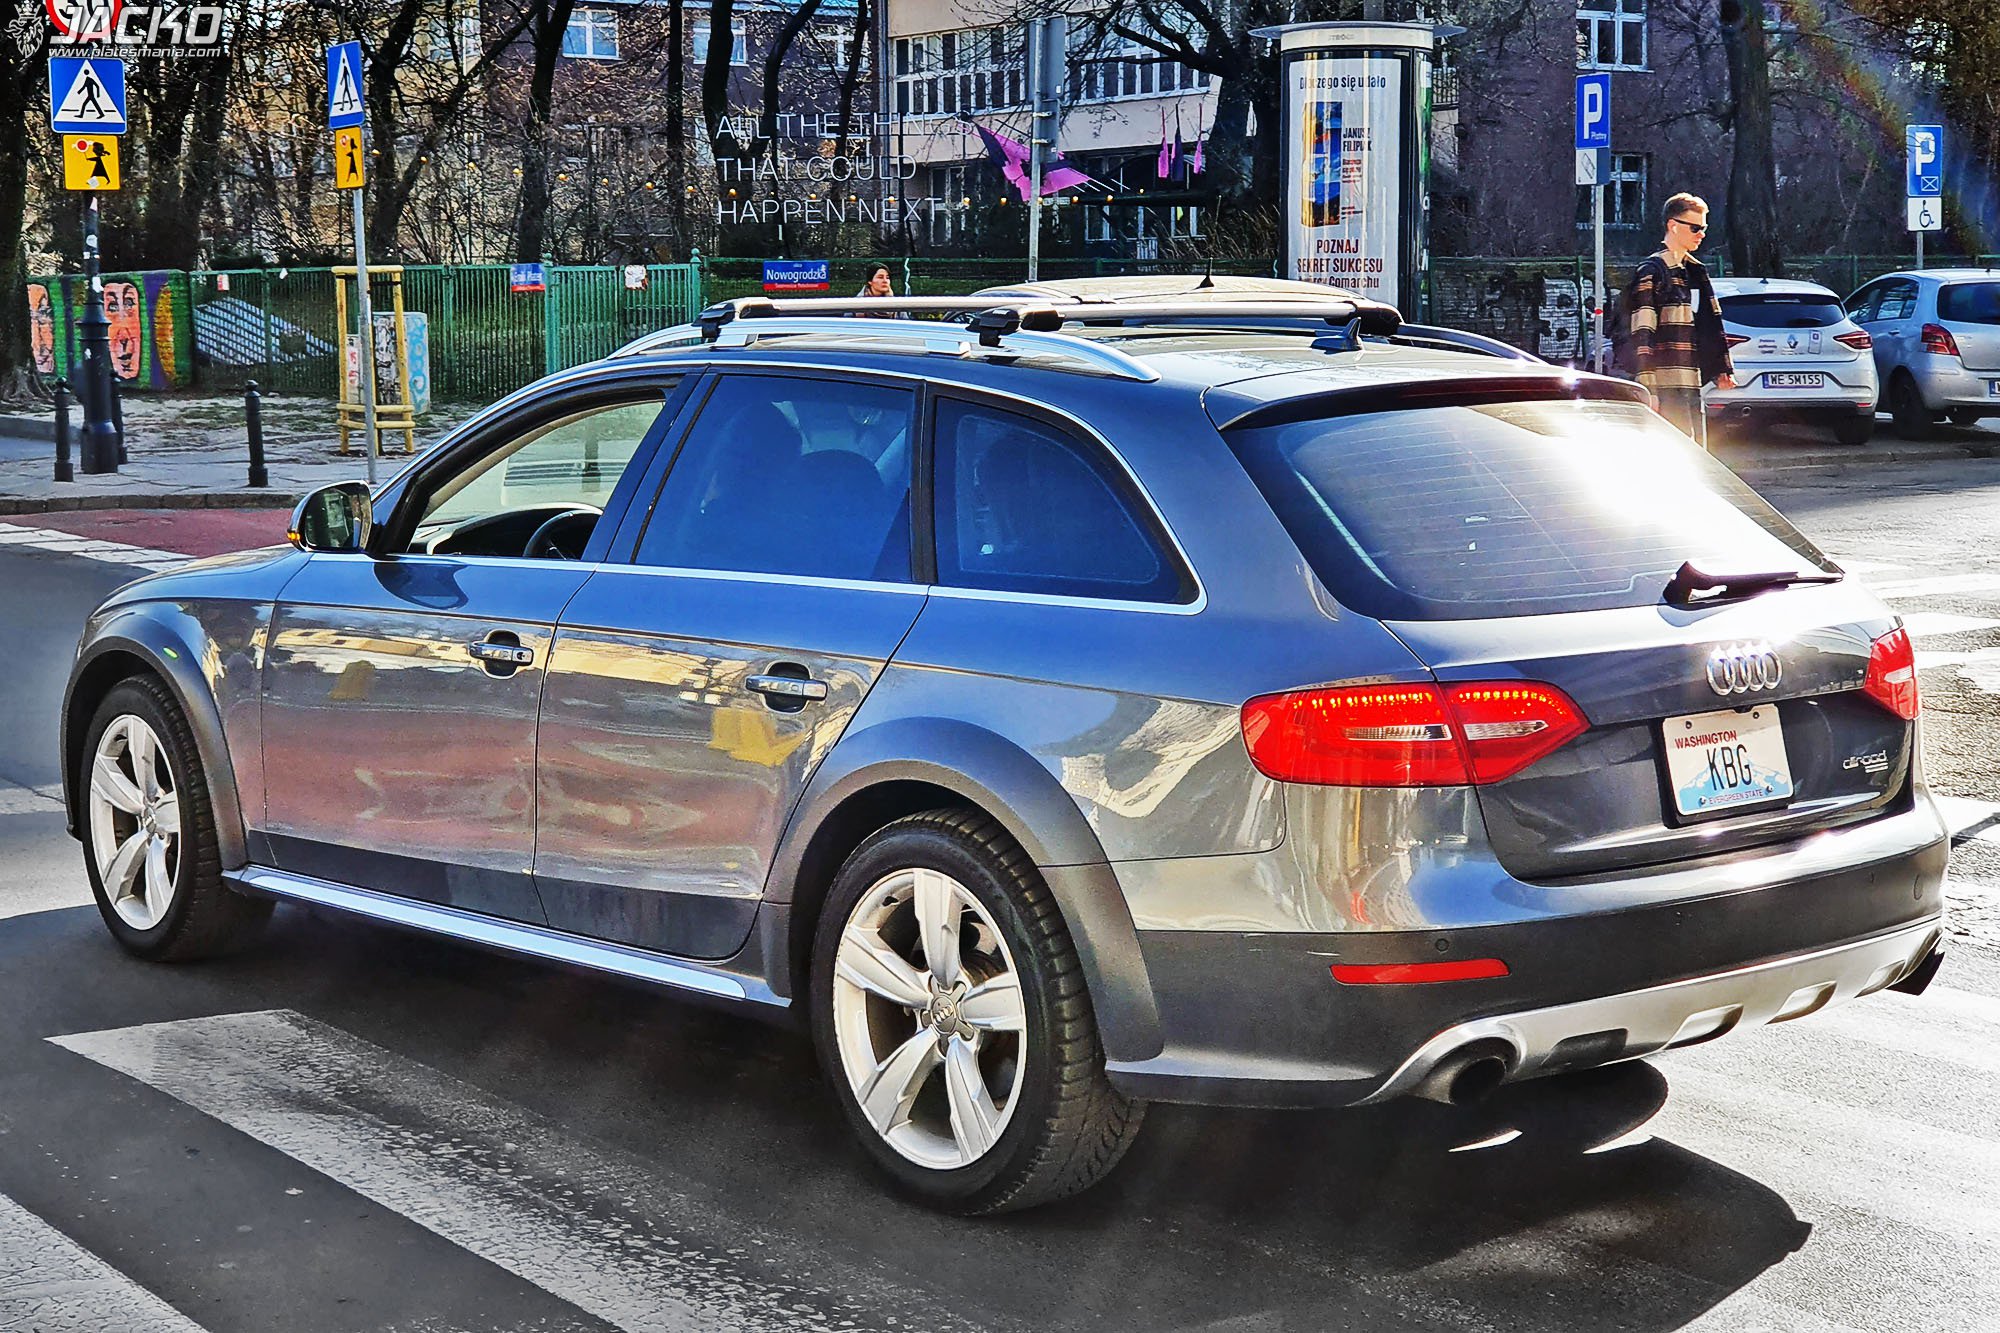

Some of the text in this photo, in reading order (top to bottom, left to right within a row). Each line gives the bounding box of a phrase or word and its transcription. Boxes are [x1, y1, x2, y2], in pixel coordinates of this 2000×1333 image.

[1340, 74, 1356, 92] się
[1584, 83, 1603, 139] P
[775, 112, 841, 138] THE
[852, 112, 975, 136] THINGS
[1915, 132, 1936, 175] P
[716, 154, 917, 182] THAT COULD
[717, 197, 943, 225] HAPPEN NEXT
[1316, 239, 1360, 254] POZNAJ
[1297, 257, 1383, 273] SEKRET SUKCESU
[766, 267, 827, 283] Nowogrodzka
[1328, 275, 1380, 289] Comarchu
[1770, 374, 1821, 385] WE 5M155
[1674, 730, 1738, 749] WASHINGTON
[1706, 743, 1753, 791] KBG
[1708, 788, 1764, 805] EVERGREEN STATE
